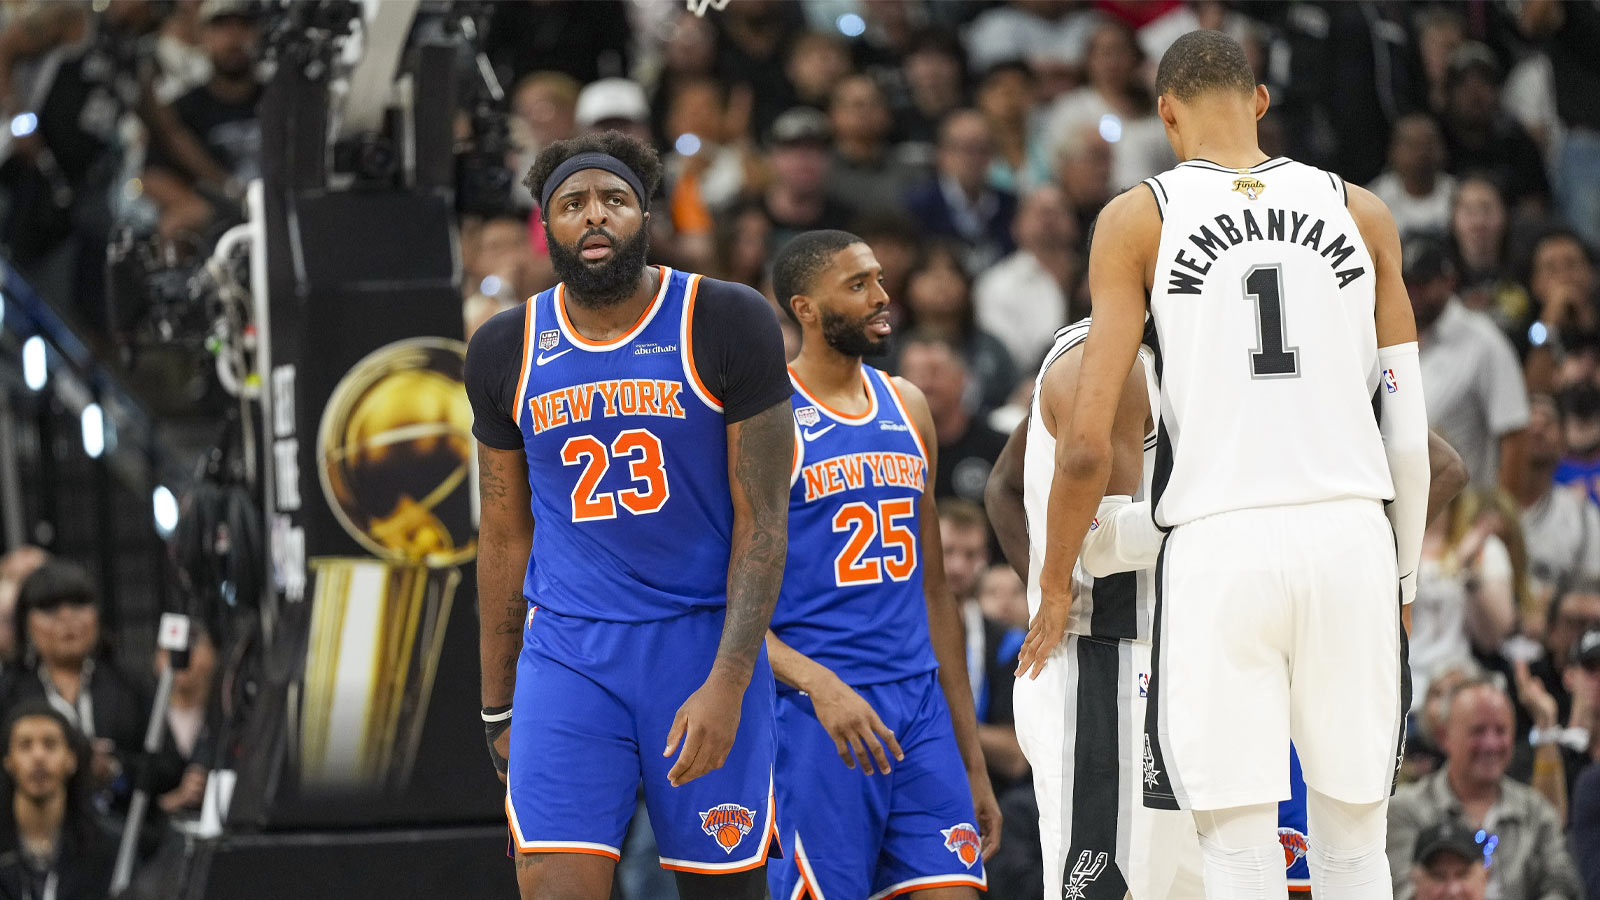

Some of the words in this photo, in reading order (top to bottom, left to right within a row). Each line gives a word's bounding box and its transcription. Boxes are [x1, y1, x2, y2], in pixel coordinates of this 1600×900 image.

[1232, 180, 1266, 191] Finals
[1167, 208, 1365, 295] WEMBANYAMA
[1241, 262, 1301, 380] 1
[634, 347, 651, 355] abu
[528, 382, 597, 435] NEW
[596, 378, 687, 419] YORK
[560, 428, 670, 523] 23
[802, 453, 865, 503] NEW
[864, 452, 924, 494] YORK
[832, 497, 917, 587] 25
[704, 809, 752, 828] KNICKS
